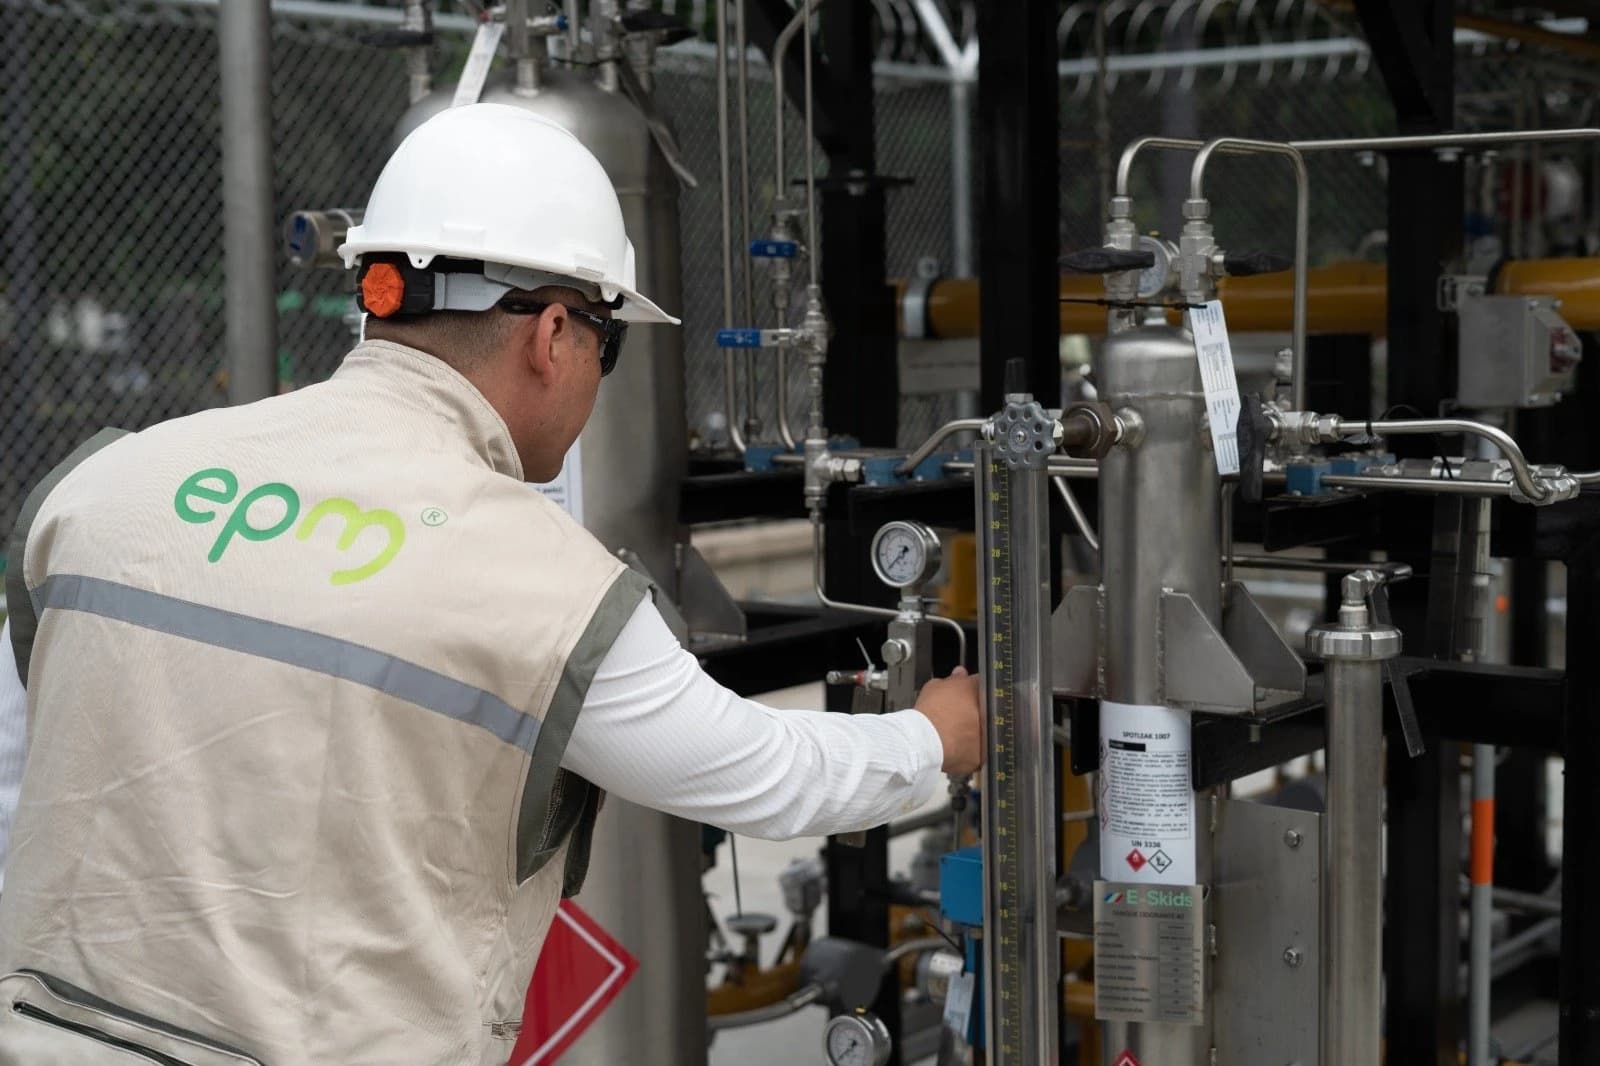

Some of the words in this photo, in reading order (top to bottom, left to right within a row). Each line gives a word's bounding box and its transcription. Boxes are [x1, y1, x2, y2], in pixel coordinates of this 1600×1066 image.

[174, 467, 406, 586] epm
[991, 521, 1000, 529] 29
[991, 549, 1000, 558] 28
[992, 577, 1001, 586] 27
[992, 605, 1002, 614] 26
[1131, 839, 1142, 848] UN
